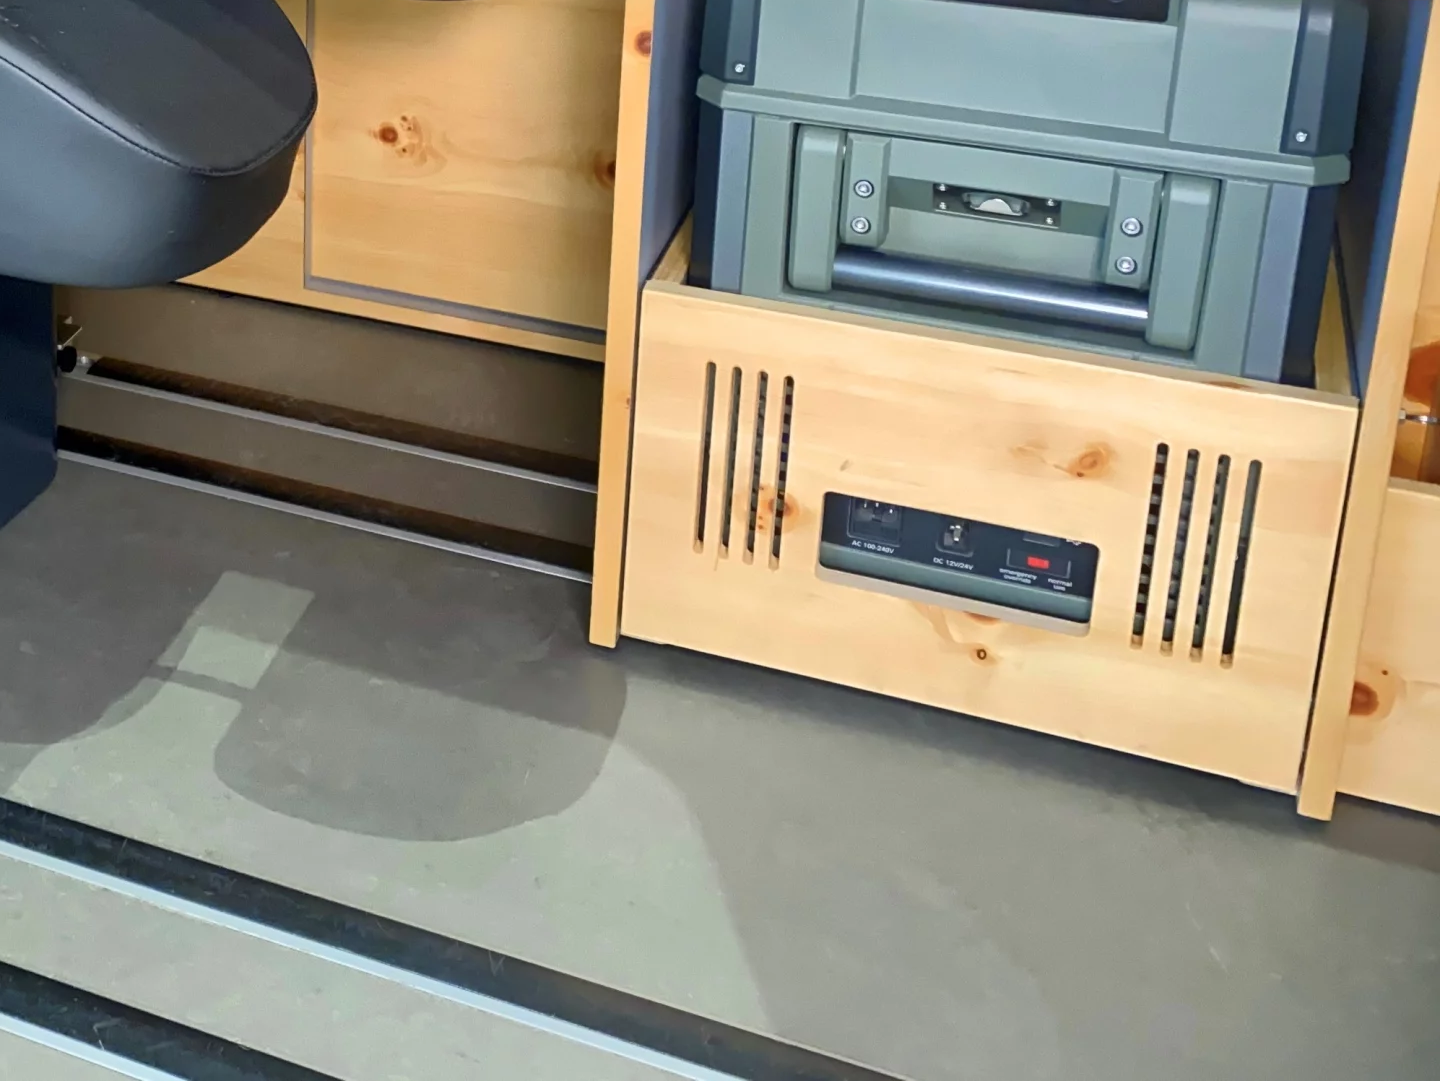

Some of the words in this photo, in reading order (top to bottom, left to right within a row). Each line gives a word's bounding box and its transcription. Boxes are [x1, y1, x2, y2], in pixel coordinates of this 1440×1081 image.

[851, 539, 862, 548] AC
[933, 556, 944, 565] DC
[946, 559, 974, 571] 12V/24V
